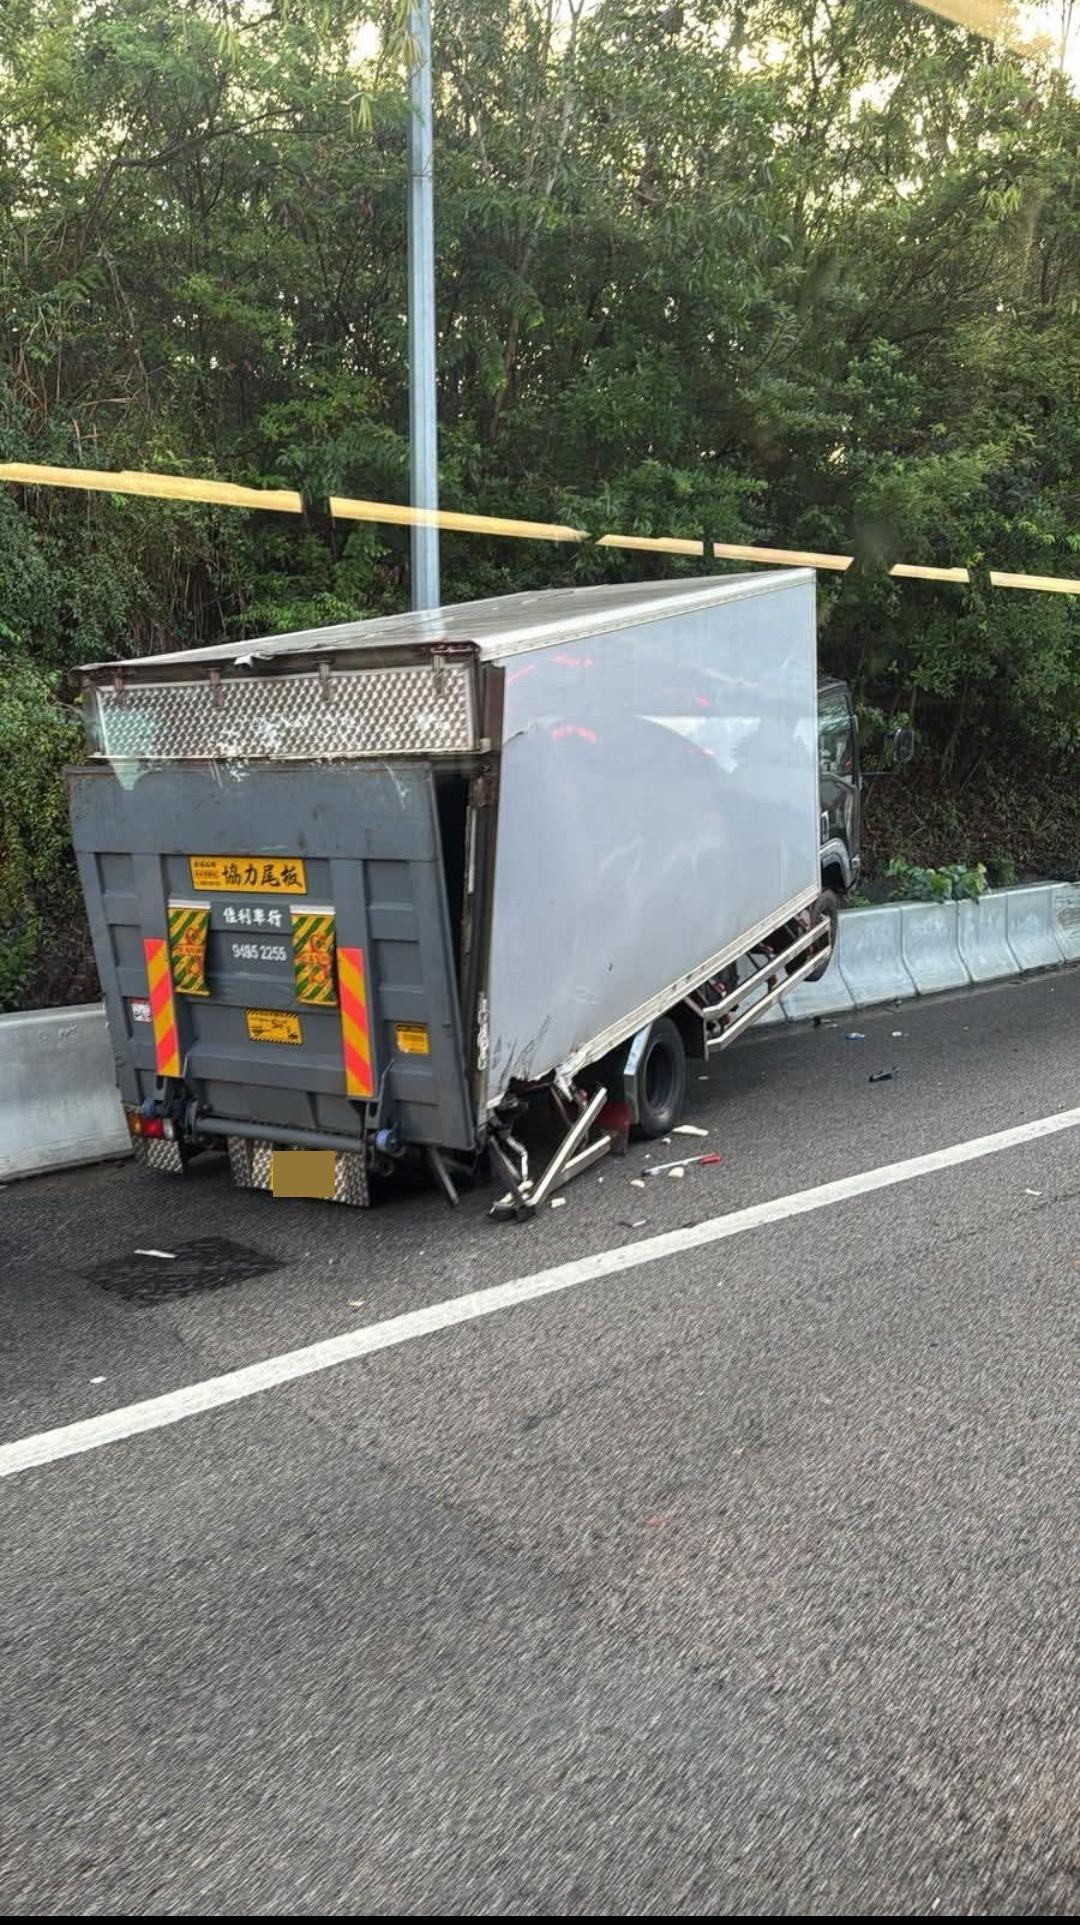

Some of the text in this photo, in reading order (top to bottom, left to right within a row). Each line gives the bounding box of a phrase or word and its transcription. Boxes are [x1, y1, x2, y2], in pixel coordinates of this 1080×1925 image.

[222, 863, 303, 888] 協力尾板
[259, 945, 288, 961] 2255
